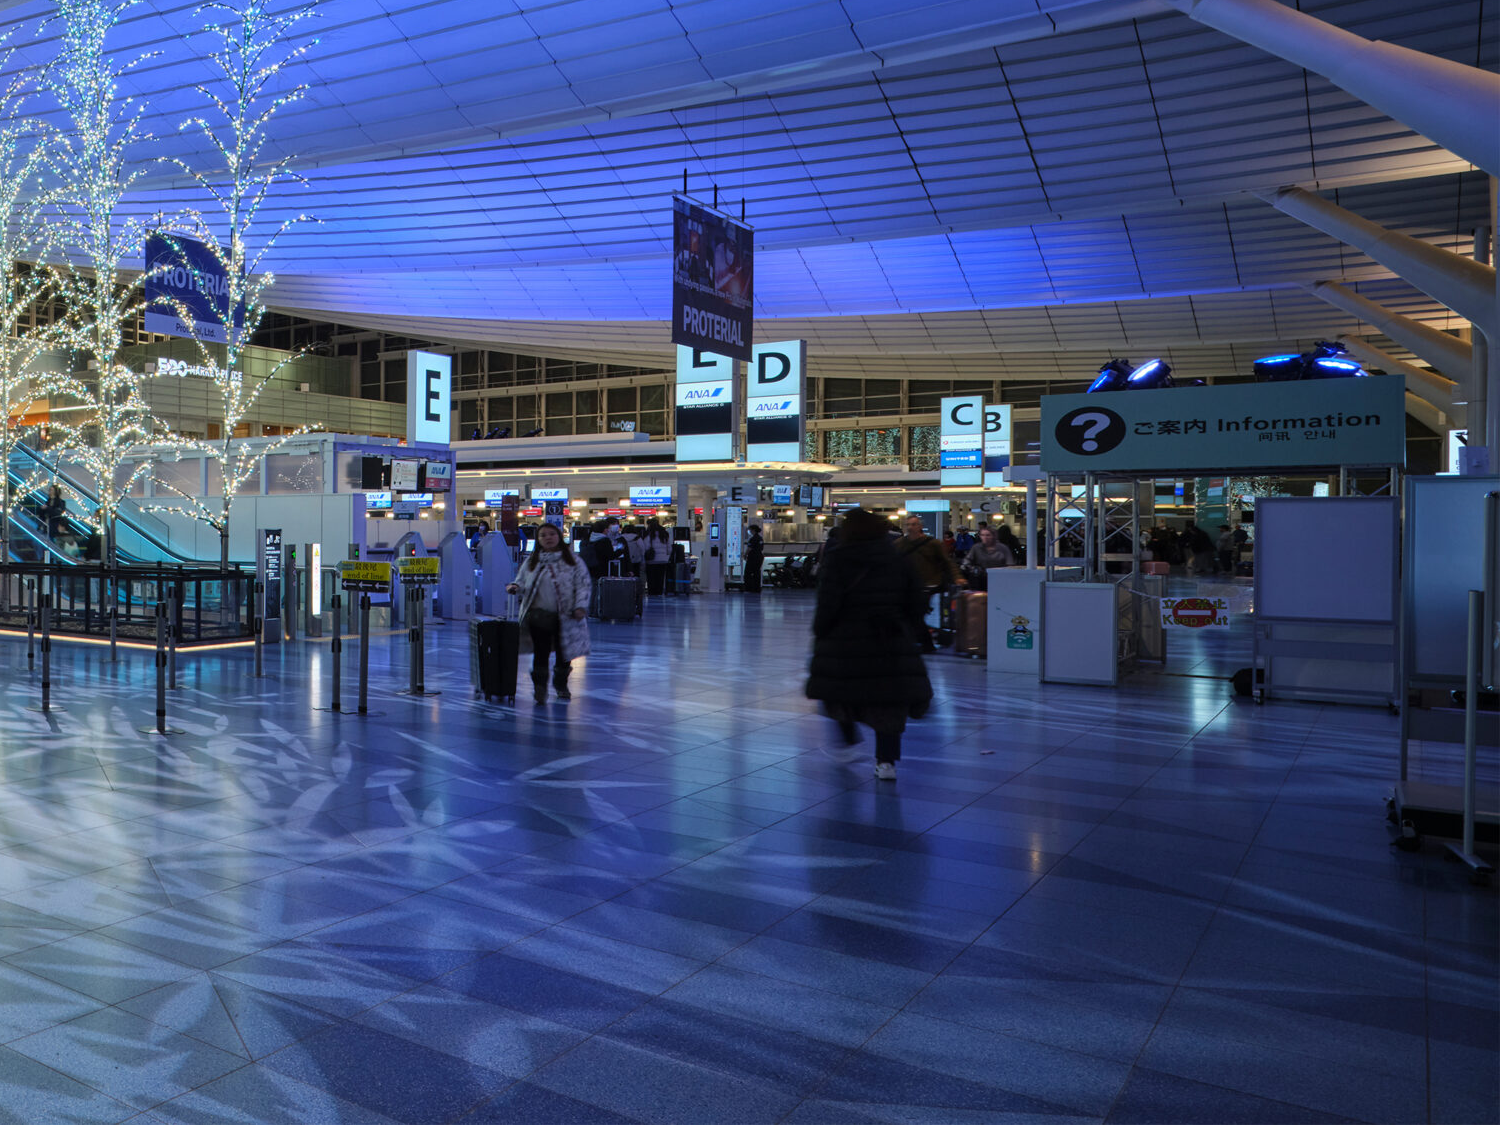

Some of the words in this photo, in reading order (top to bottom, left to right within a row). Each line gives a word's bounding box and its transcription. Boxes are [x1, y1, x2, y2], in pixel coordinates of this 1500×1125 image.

[683, 304, 745, 347] PROTERIAL
[158, 357, 188, 378] EDO
[757, 352, 791, 384] D
[425, 369, 441, 422] E
[685, 390, 710, 399] ANA
[755, 403, 779, 412] ANA
[951, 403, 973, 426] C
[985, 412, 1002, 433] B
[1134, 420, 1207, 436] ご案内
[1217, 412, 1381, 433] Information
[1303, 429, 1336, 441] 안내
[732, 486, 743, 501] E
[980, 502, 990, 512] C
[1162, 598, 1227, 611] 立入禁止
[1162, 615, 1198, 627] Keep
[1203, 615, 1229, 626] out
